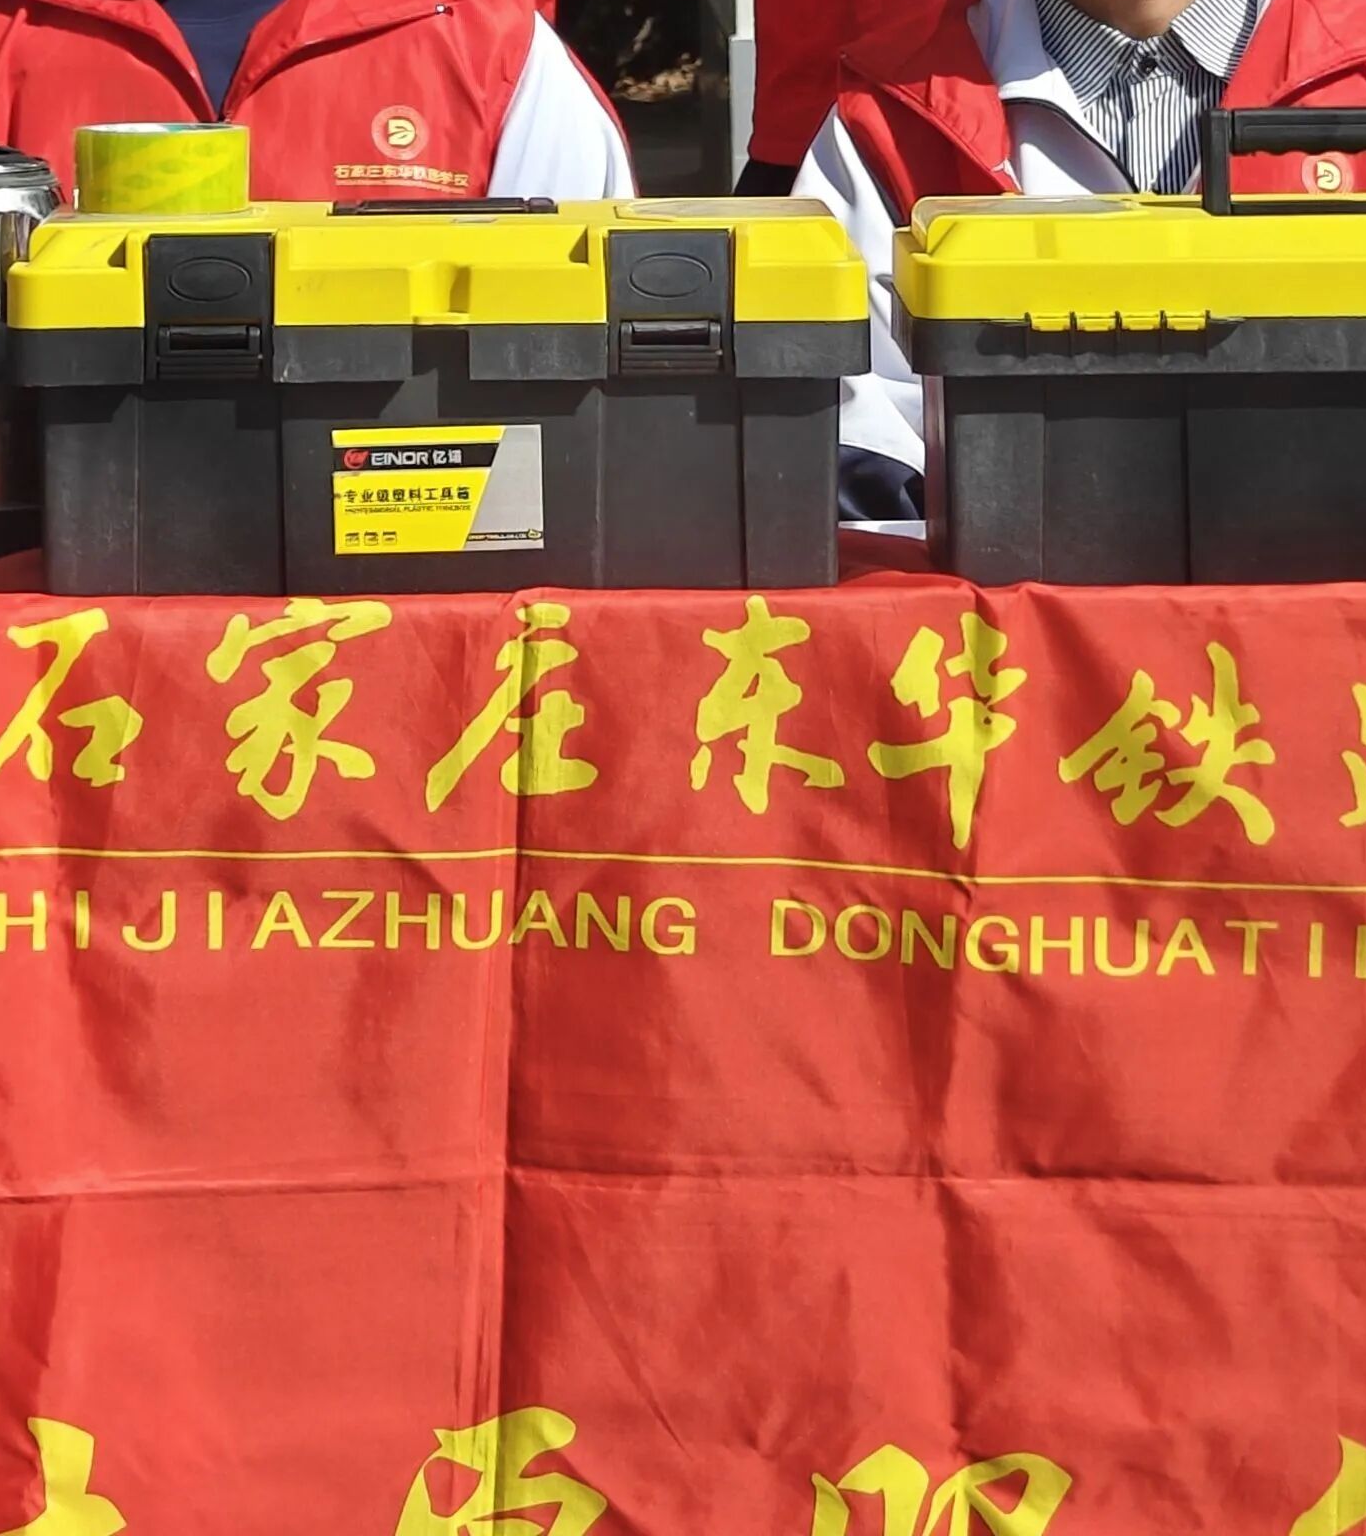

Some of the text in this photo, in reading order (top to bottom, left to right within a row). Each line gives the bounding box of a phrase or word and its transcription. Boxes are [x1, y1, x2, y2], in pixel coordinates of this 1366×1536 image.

[370, 451, 429, 466] EINOR
[343, 486, 471, 503] 专业级塑料工具箱
